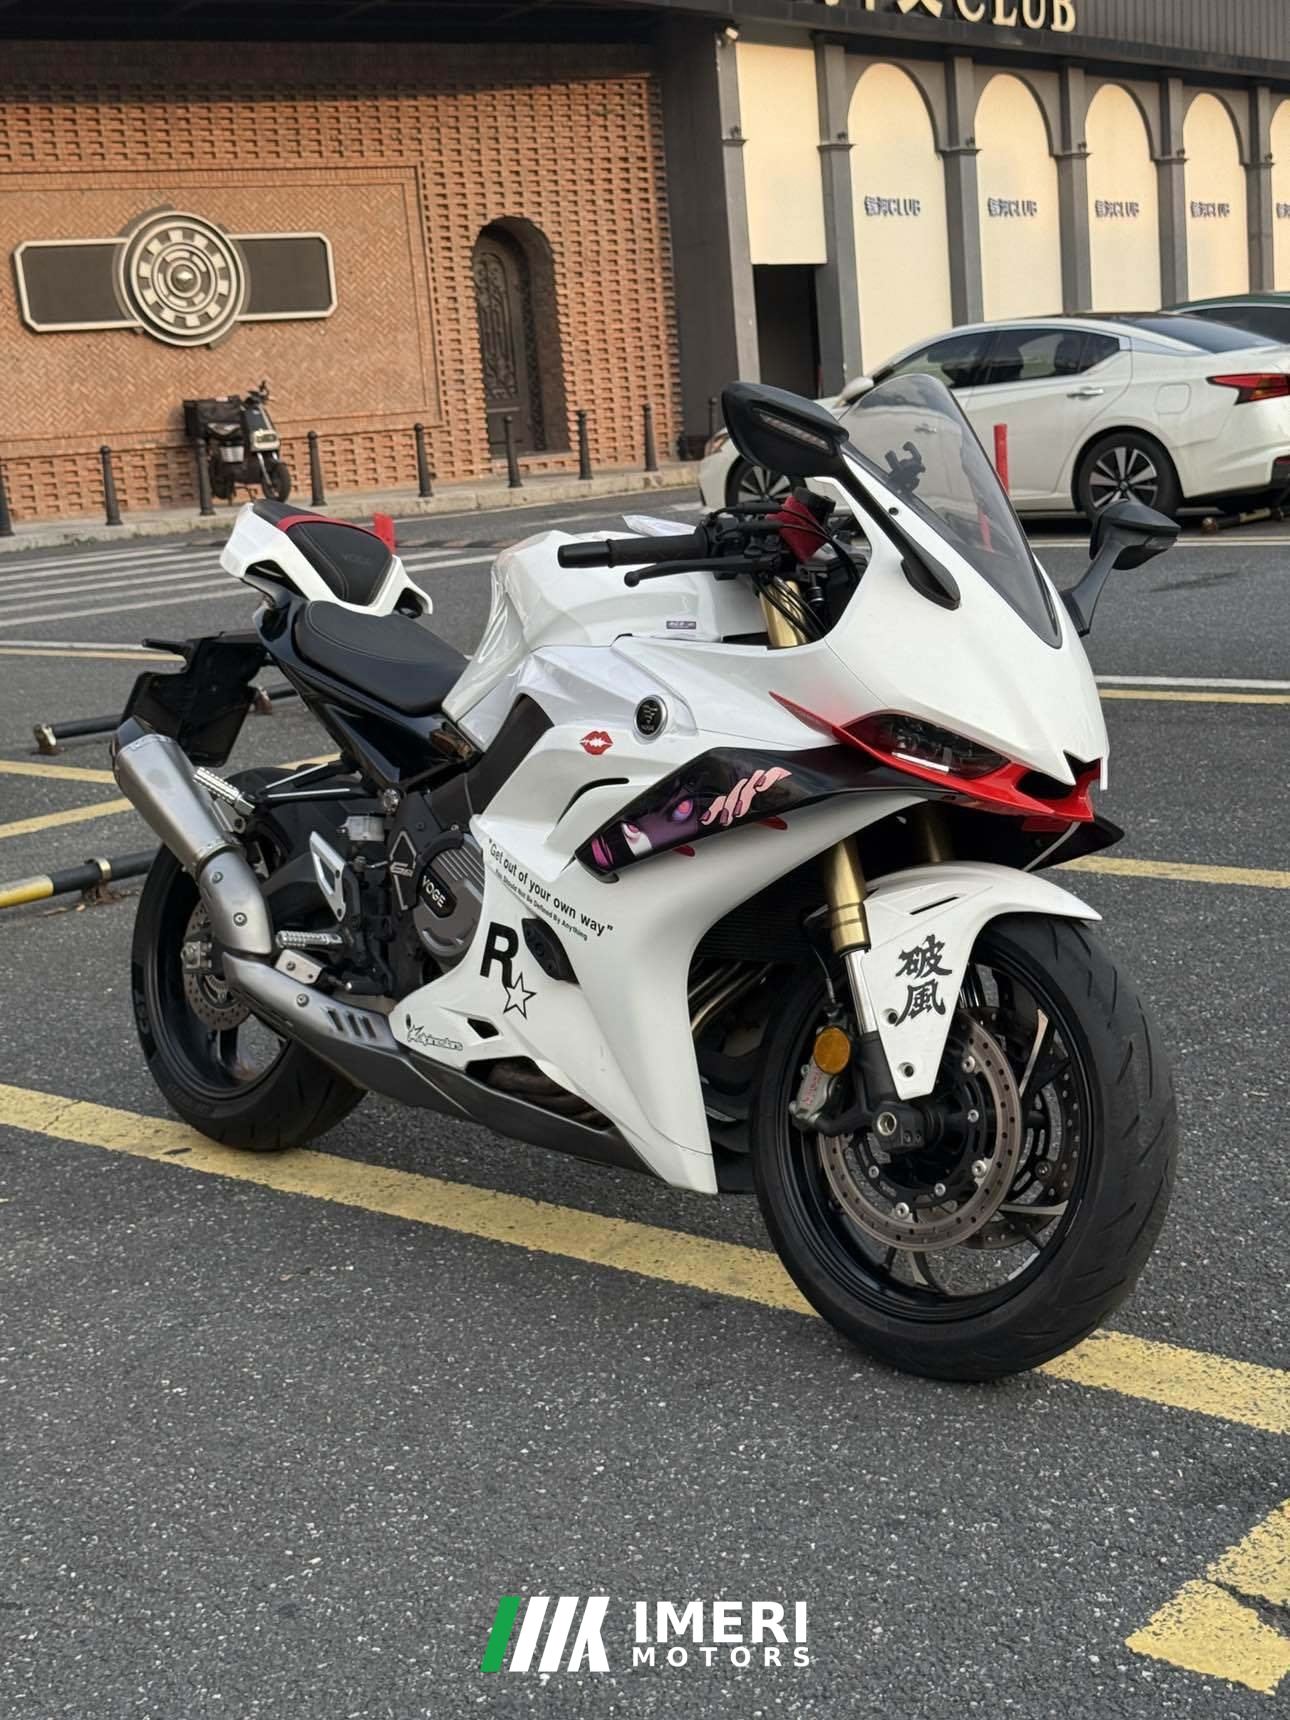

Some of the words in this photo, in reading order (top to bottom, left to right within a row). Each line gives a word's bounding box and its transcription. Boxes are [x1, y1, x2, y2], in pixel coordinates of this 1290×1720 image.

[957, 0, 1076, 32] CLUB
[422, 875, 446, 908] VOGE
[503, 858, 518, 877] out
[518, 871, 529, 885] of
[529, 879, 551, 901] your
[553, 898, 576, 918] own
[561, 919, 589, 942] Anything
[896, 934, 953, 1027] 破風
